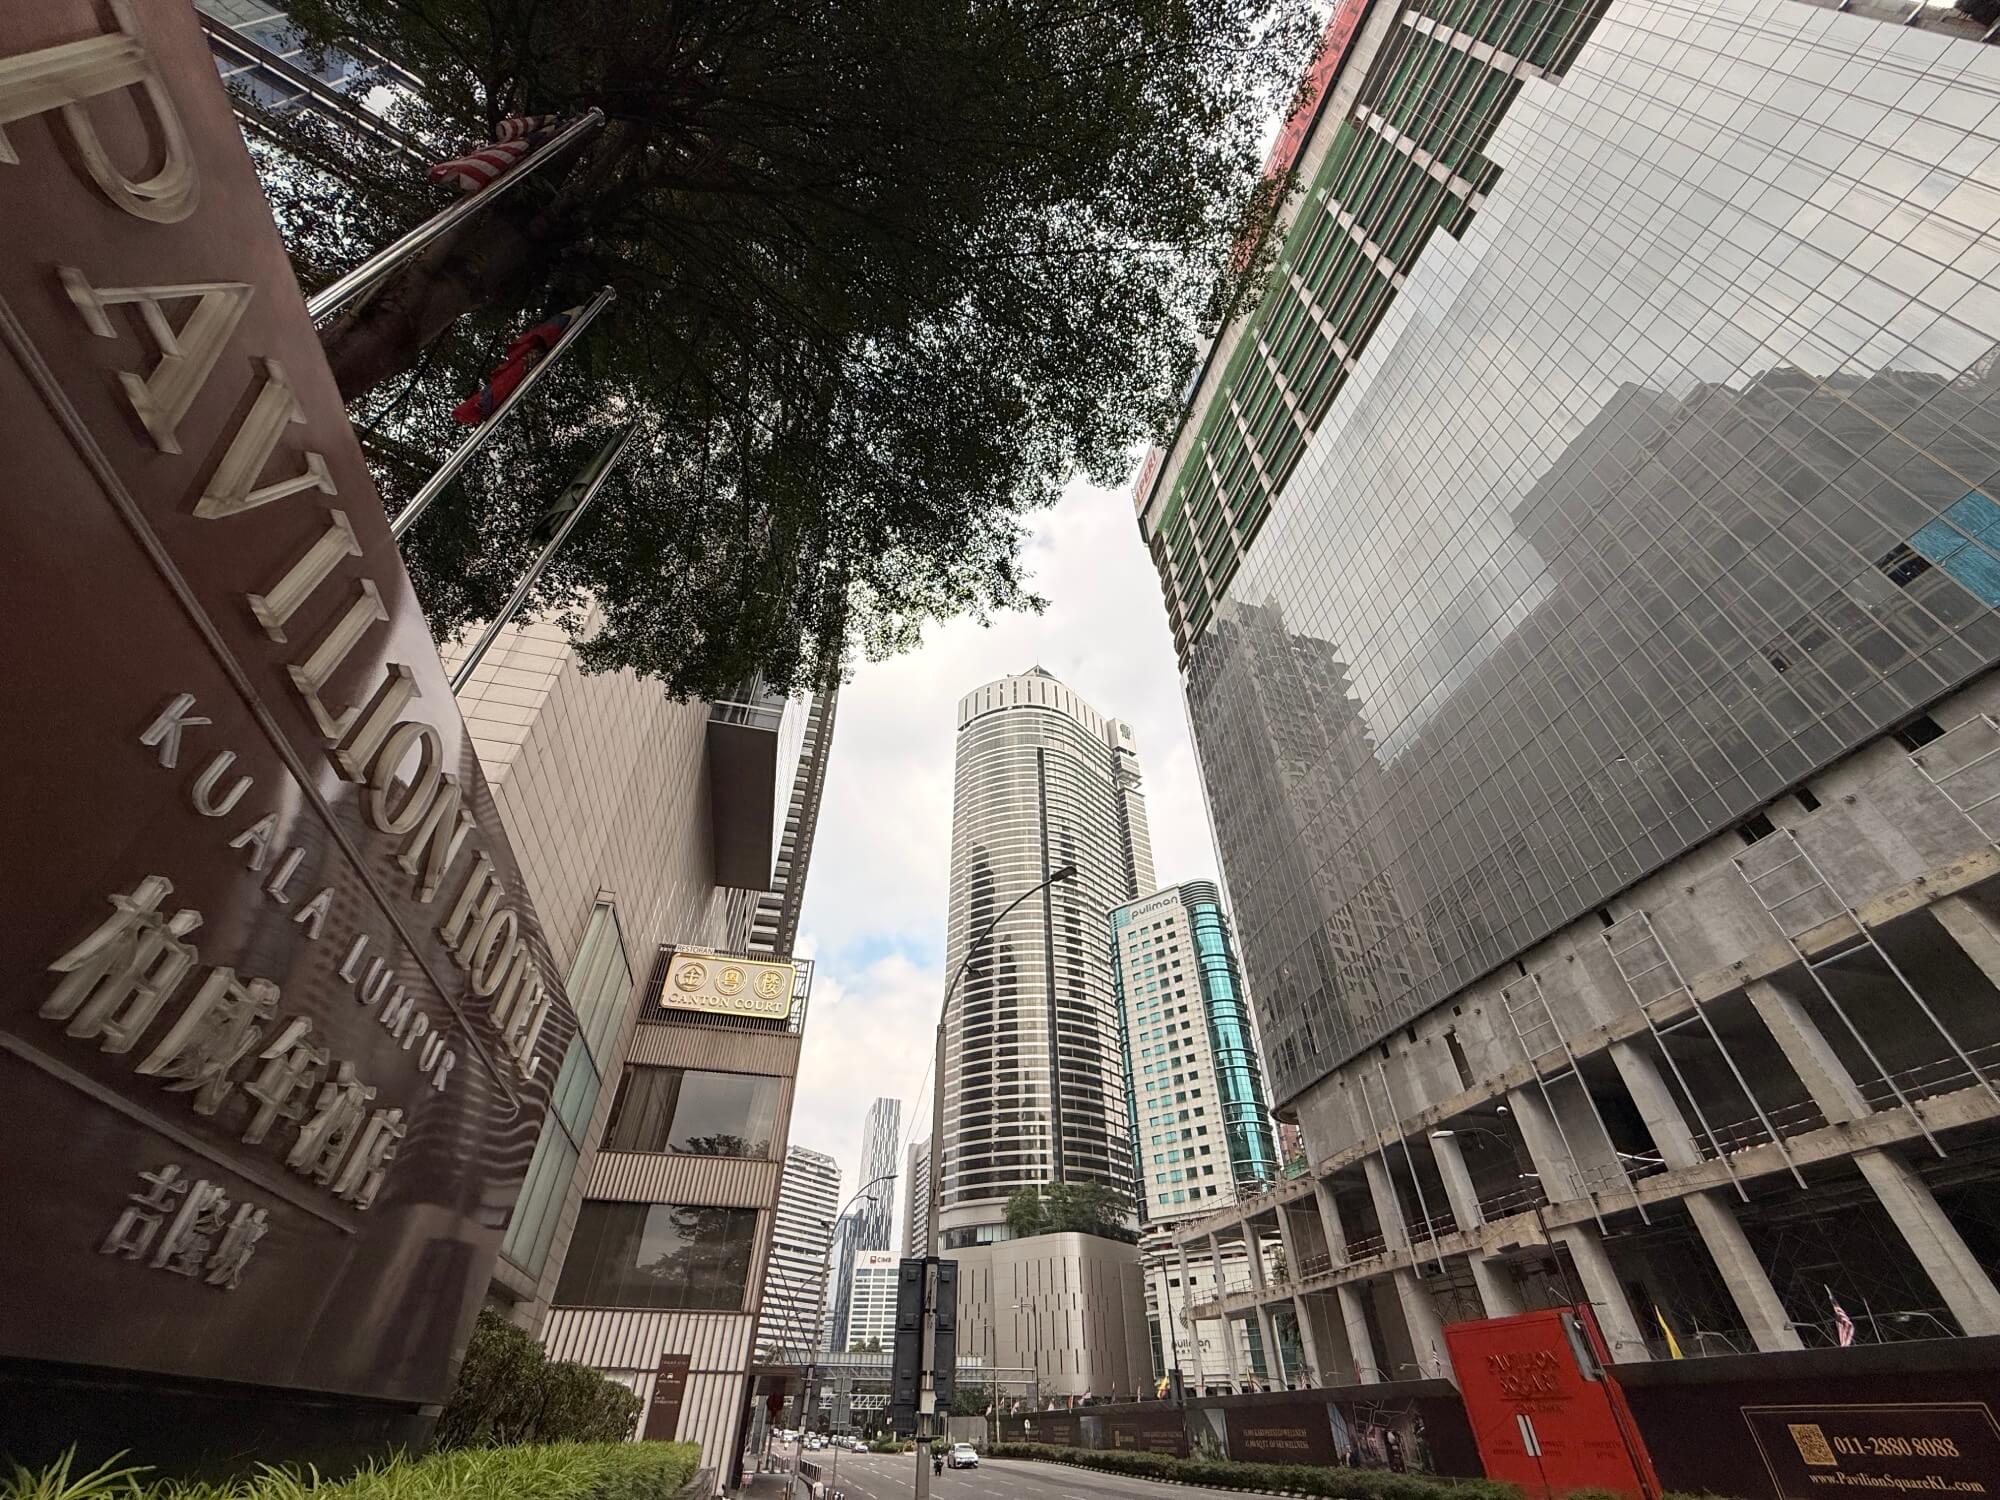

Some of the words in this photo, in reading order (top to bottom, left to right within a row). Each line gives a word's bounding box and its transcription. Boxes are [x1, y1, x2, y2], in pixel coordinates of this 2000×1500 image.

[0, 0, 476, 904] PAVILION
[440, 850, 553, 1080] HOTEL
[138, 693, 336, 940] KUALA
[338, 934, 457, 1092] LUMPUR
[1131, 896, 1178, 920] pullman
[676, 944, 715, 954] RESTORAN
[668, 992, 730, 1008] CANTON
[734, 998, 783, 1013] COURT
[1833, 1436, 1912, 1456] 011-2880
[1911, 1437, 1960, 1458] 8088
[1808, 1471, 1986, 1493] www.PavilionSquareKL.com
